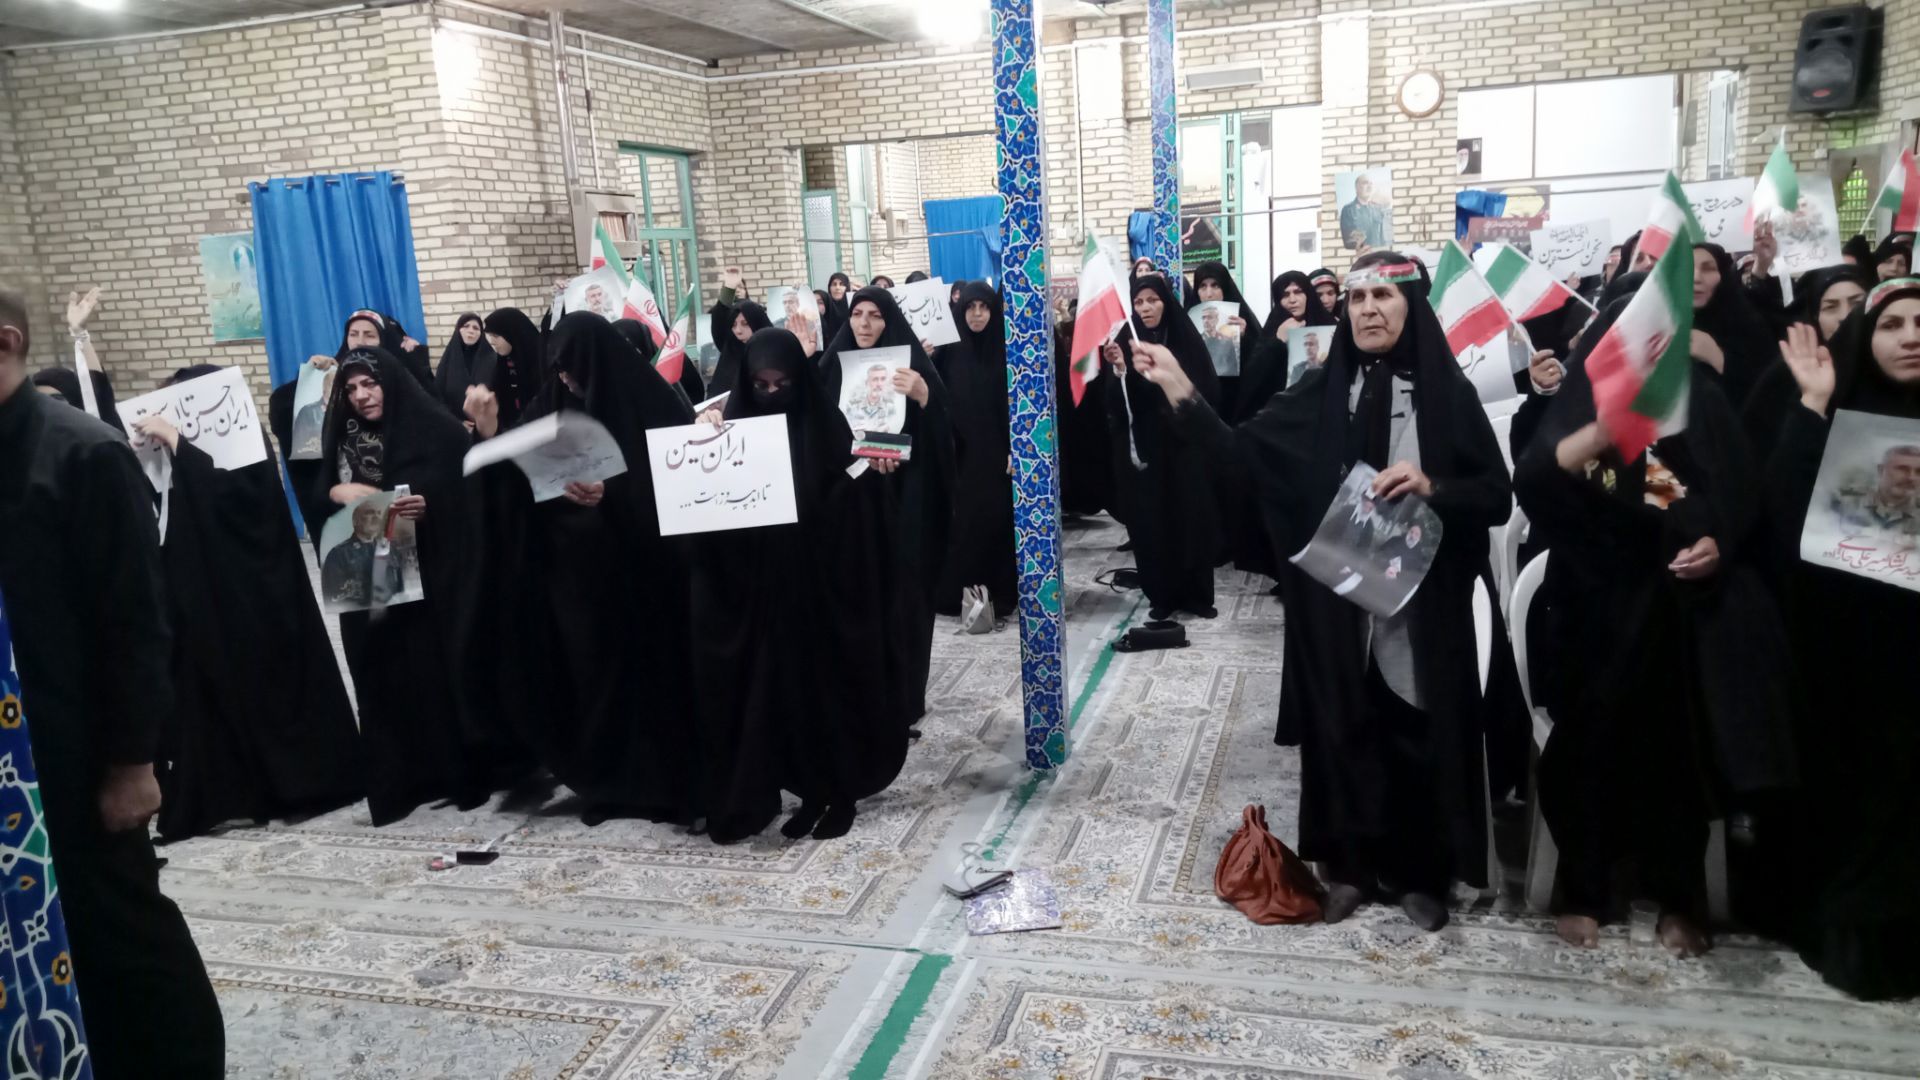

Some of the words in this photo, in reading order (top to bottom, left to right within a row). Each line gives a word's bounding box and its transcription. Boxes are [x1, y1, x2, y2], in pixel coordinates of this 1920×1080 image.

[181, 385, 231, 441] حسین
[215, 394, 250, 437] ایران
[665, 421, 737, 470] حسین
[700, 432, 745, 473] ایران
